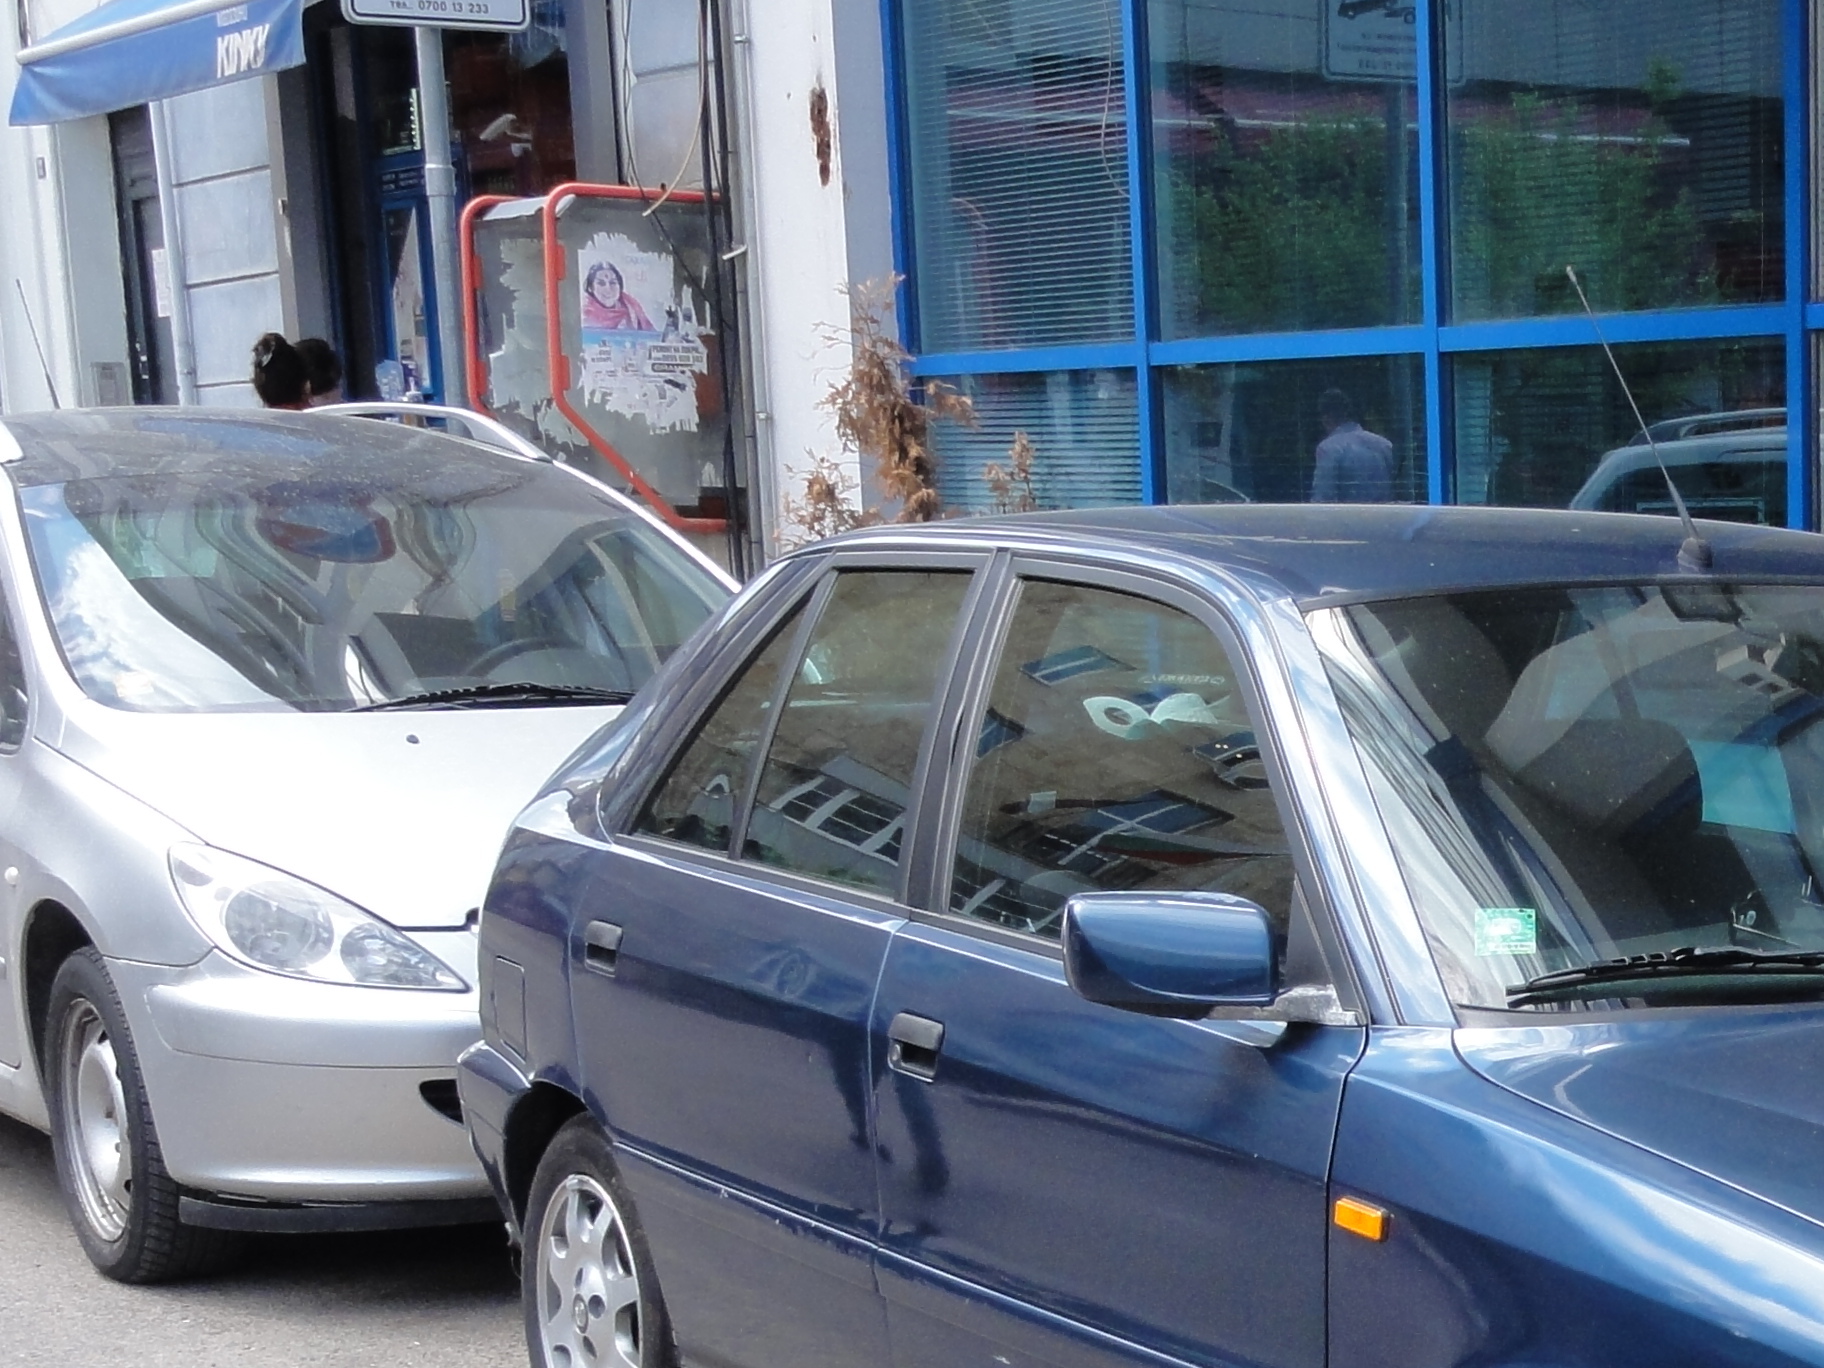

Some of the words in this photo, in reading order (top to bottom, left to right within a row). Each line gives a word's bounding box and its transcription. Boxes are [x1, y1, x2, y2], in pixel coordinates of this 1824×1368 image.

[418, 0, 447, 12] 0700
[452, 2, 463, 13] 13
[468, 3, 489, 14] 233
[216, 23, 270, 79] KINKY
